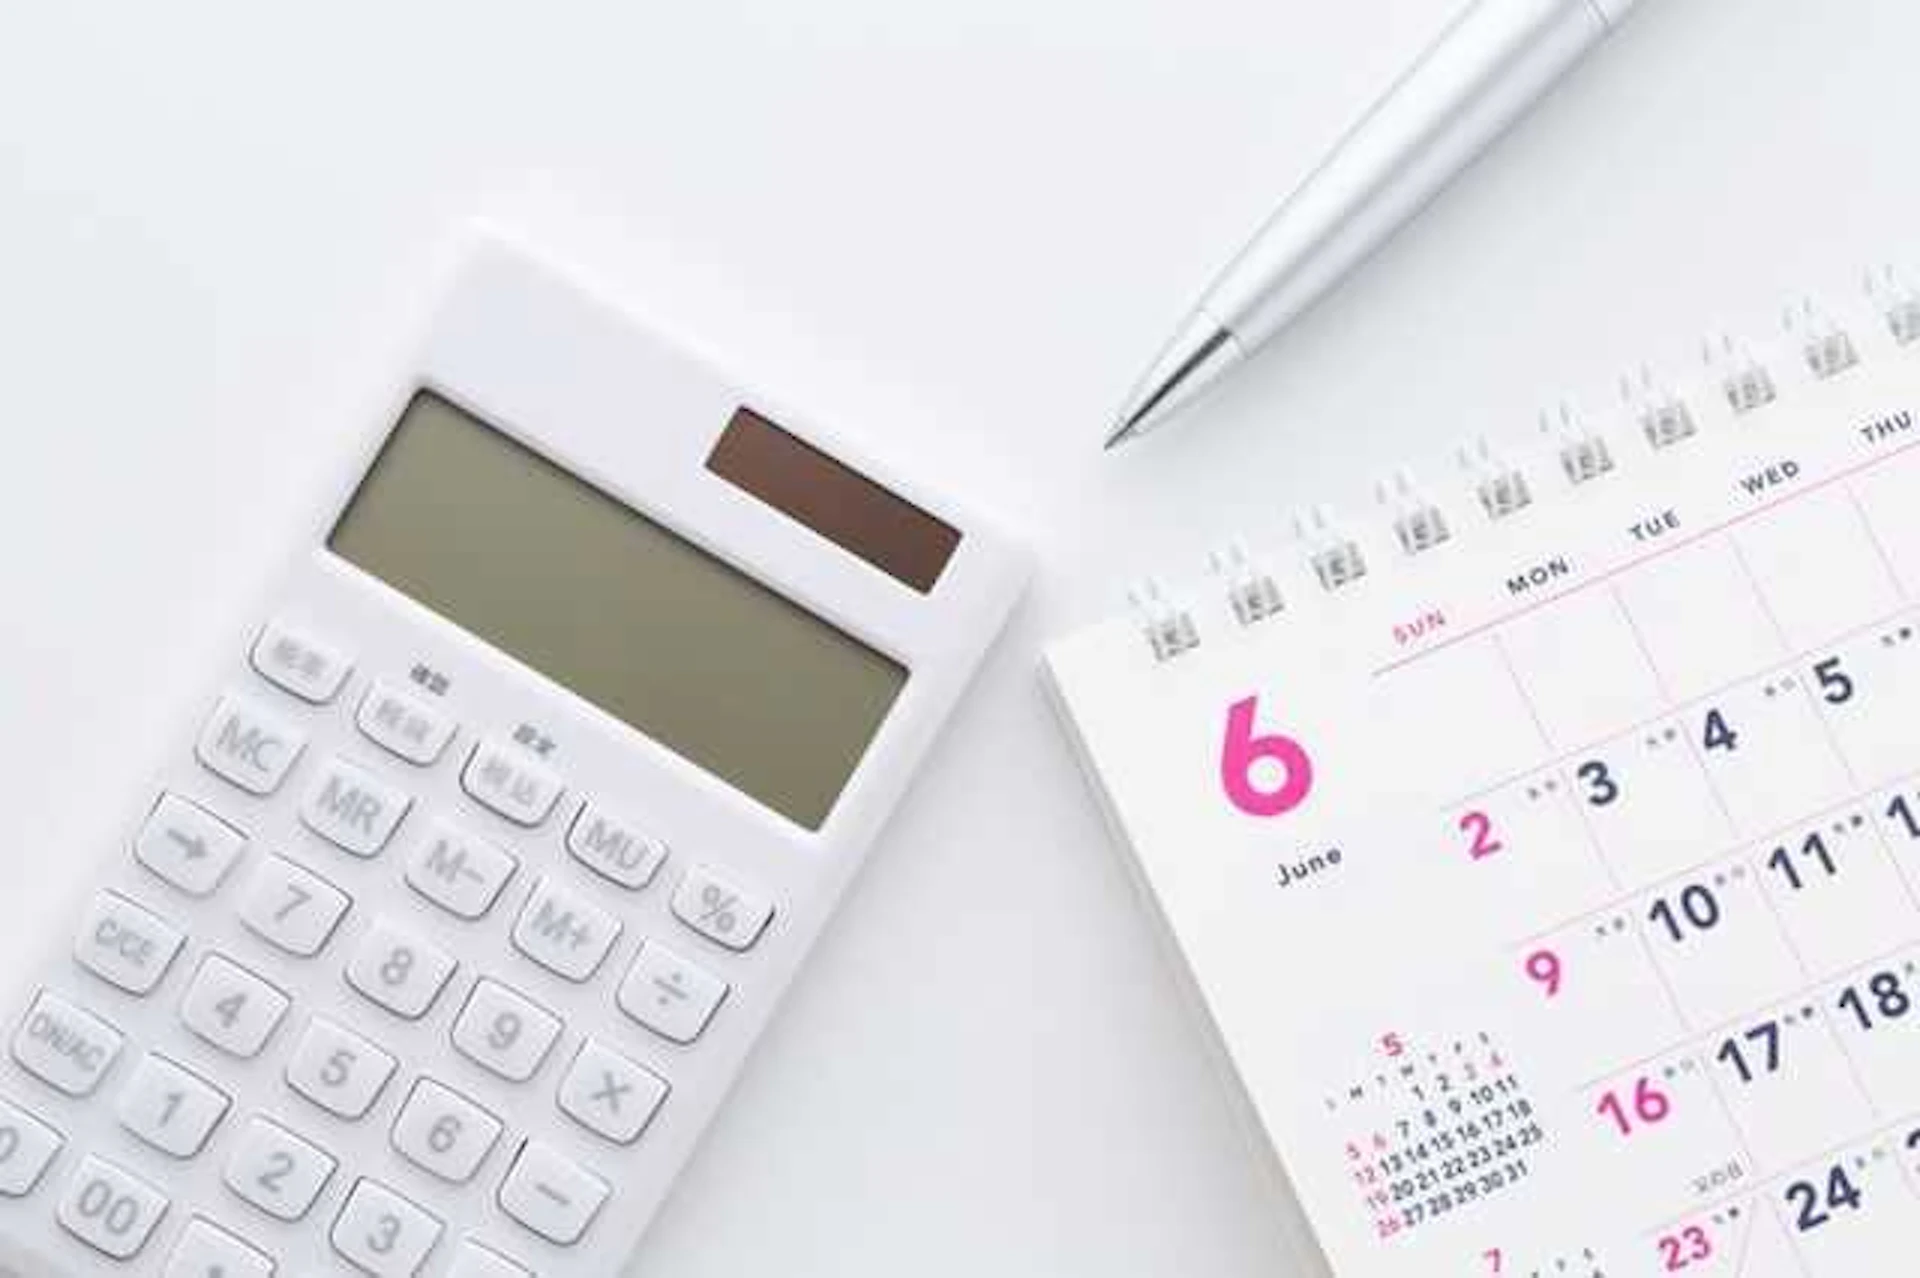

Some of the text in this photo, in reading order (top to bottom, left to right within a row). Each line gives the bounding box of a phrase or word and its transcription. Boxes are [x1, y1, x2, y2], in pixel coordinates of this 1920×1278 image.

[1394, 411, 1912, 645] SUN MON TUE WED THU
[217, 715, 281, 772] MC
[1221, 695, 1313, 816] 6
[1460, 656, 1854, 860] 2 3 4 5
[318, 776, 381, 834] MR
[584, 819, 648, 871] MU
[1277, 848, 1342, 888] June
[275, 884, 312, 921] 7
[1526, 795, 1920, 996] 9 10 11 1
[380, 947, 414, 986] 8
[216, 993, 248, 1028] 4
[488, 1012, 522, 1049] 9
[1382, 1031, 1402, 1056] 5
[1596, 972, 1910, 1135] 16 17 18
[320, 1050, 356, 1088] 5
[160, 1092, 184, 1127] 1
[427, 1115, 462, 1153] 6
[256, 1153, 294, 1193] 2
[79, 1179, 139, 1235] 00
[1658, 1226, 1711, 1272] 23
[1785, 1165, 1861, 1232] 24
[367, 1216, 400, 1256] 3
[1485, 1248, 1501, 1272] 7
